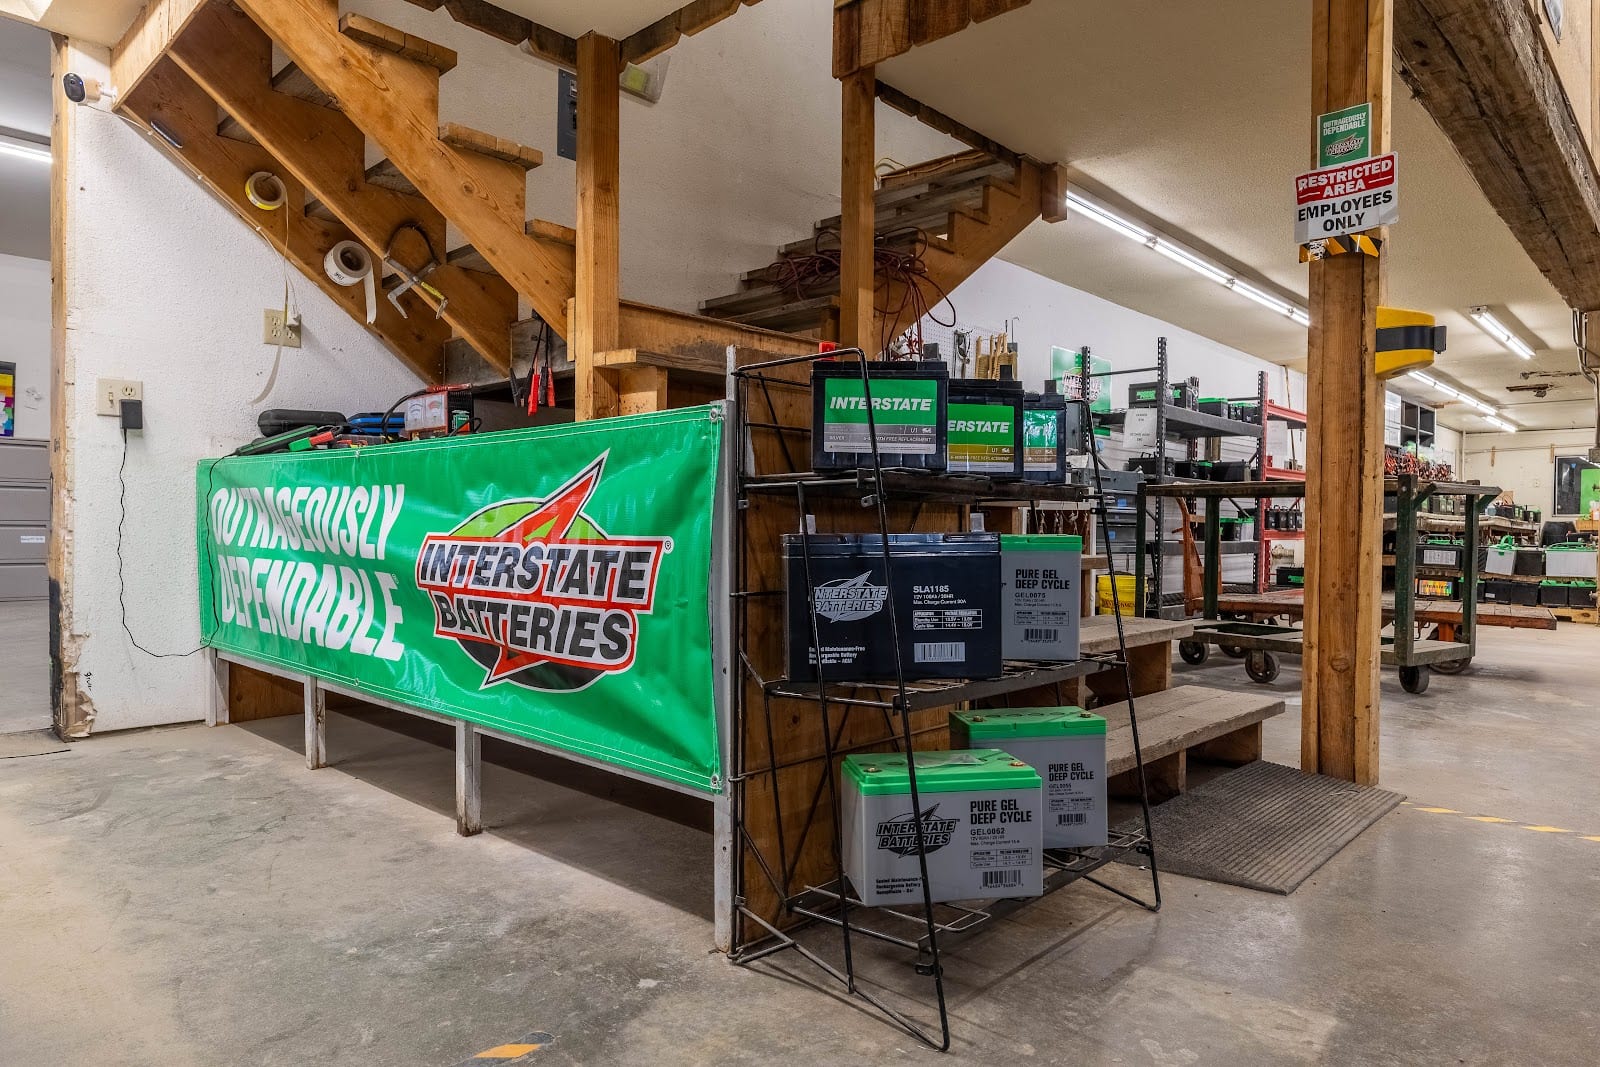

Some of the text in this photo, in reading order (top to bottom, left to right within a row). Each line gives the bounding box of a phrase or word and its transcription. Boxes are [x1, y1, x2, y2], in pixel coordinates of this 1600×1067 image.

[1323, 112, 1366, 128] OUTRAGEOUSLY
[1323, 119, 1366, 136] DEPENDABLE
[1298, 159, 1392, 191] RESTRICTED
[1322, 179, 1366, 198] AREA
[1298, 190, 1392, 222] EMPLOYEES
[1323, 212, 1365, 232] ONLY
[830, 397, 932, 411] INTERSTATE
[211, 484, 404, 560] OUTRAGEOUSLY
[420, 543, 652, 599] INTERSTATE
[1016, 569, 1058, 579] PURE GEL
[913, 585, 950, 593] SLA1185
[1016, 580, 1070, 589] DEEP CYCLE
[815, 588, 886, 599] NTERSTATE
[218, 554, 404, 662] DEPENDABLE
[432, 594, 632, 660] BATTERIES
[1049, 762, 1084, 772] PURE GEL
[1049, 771, 1094, 781] DEEP CYCLE
[970, 799, 1019, 812] PURE GEL
[970, 811, 1032, 824] DEEP CYCLE
